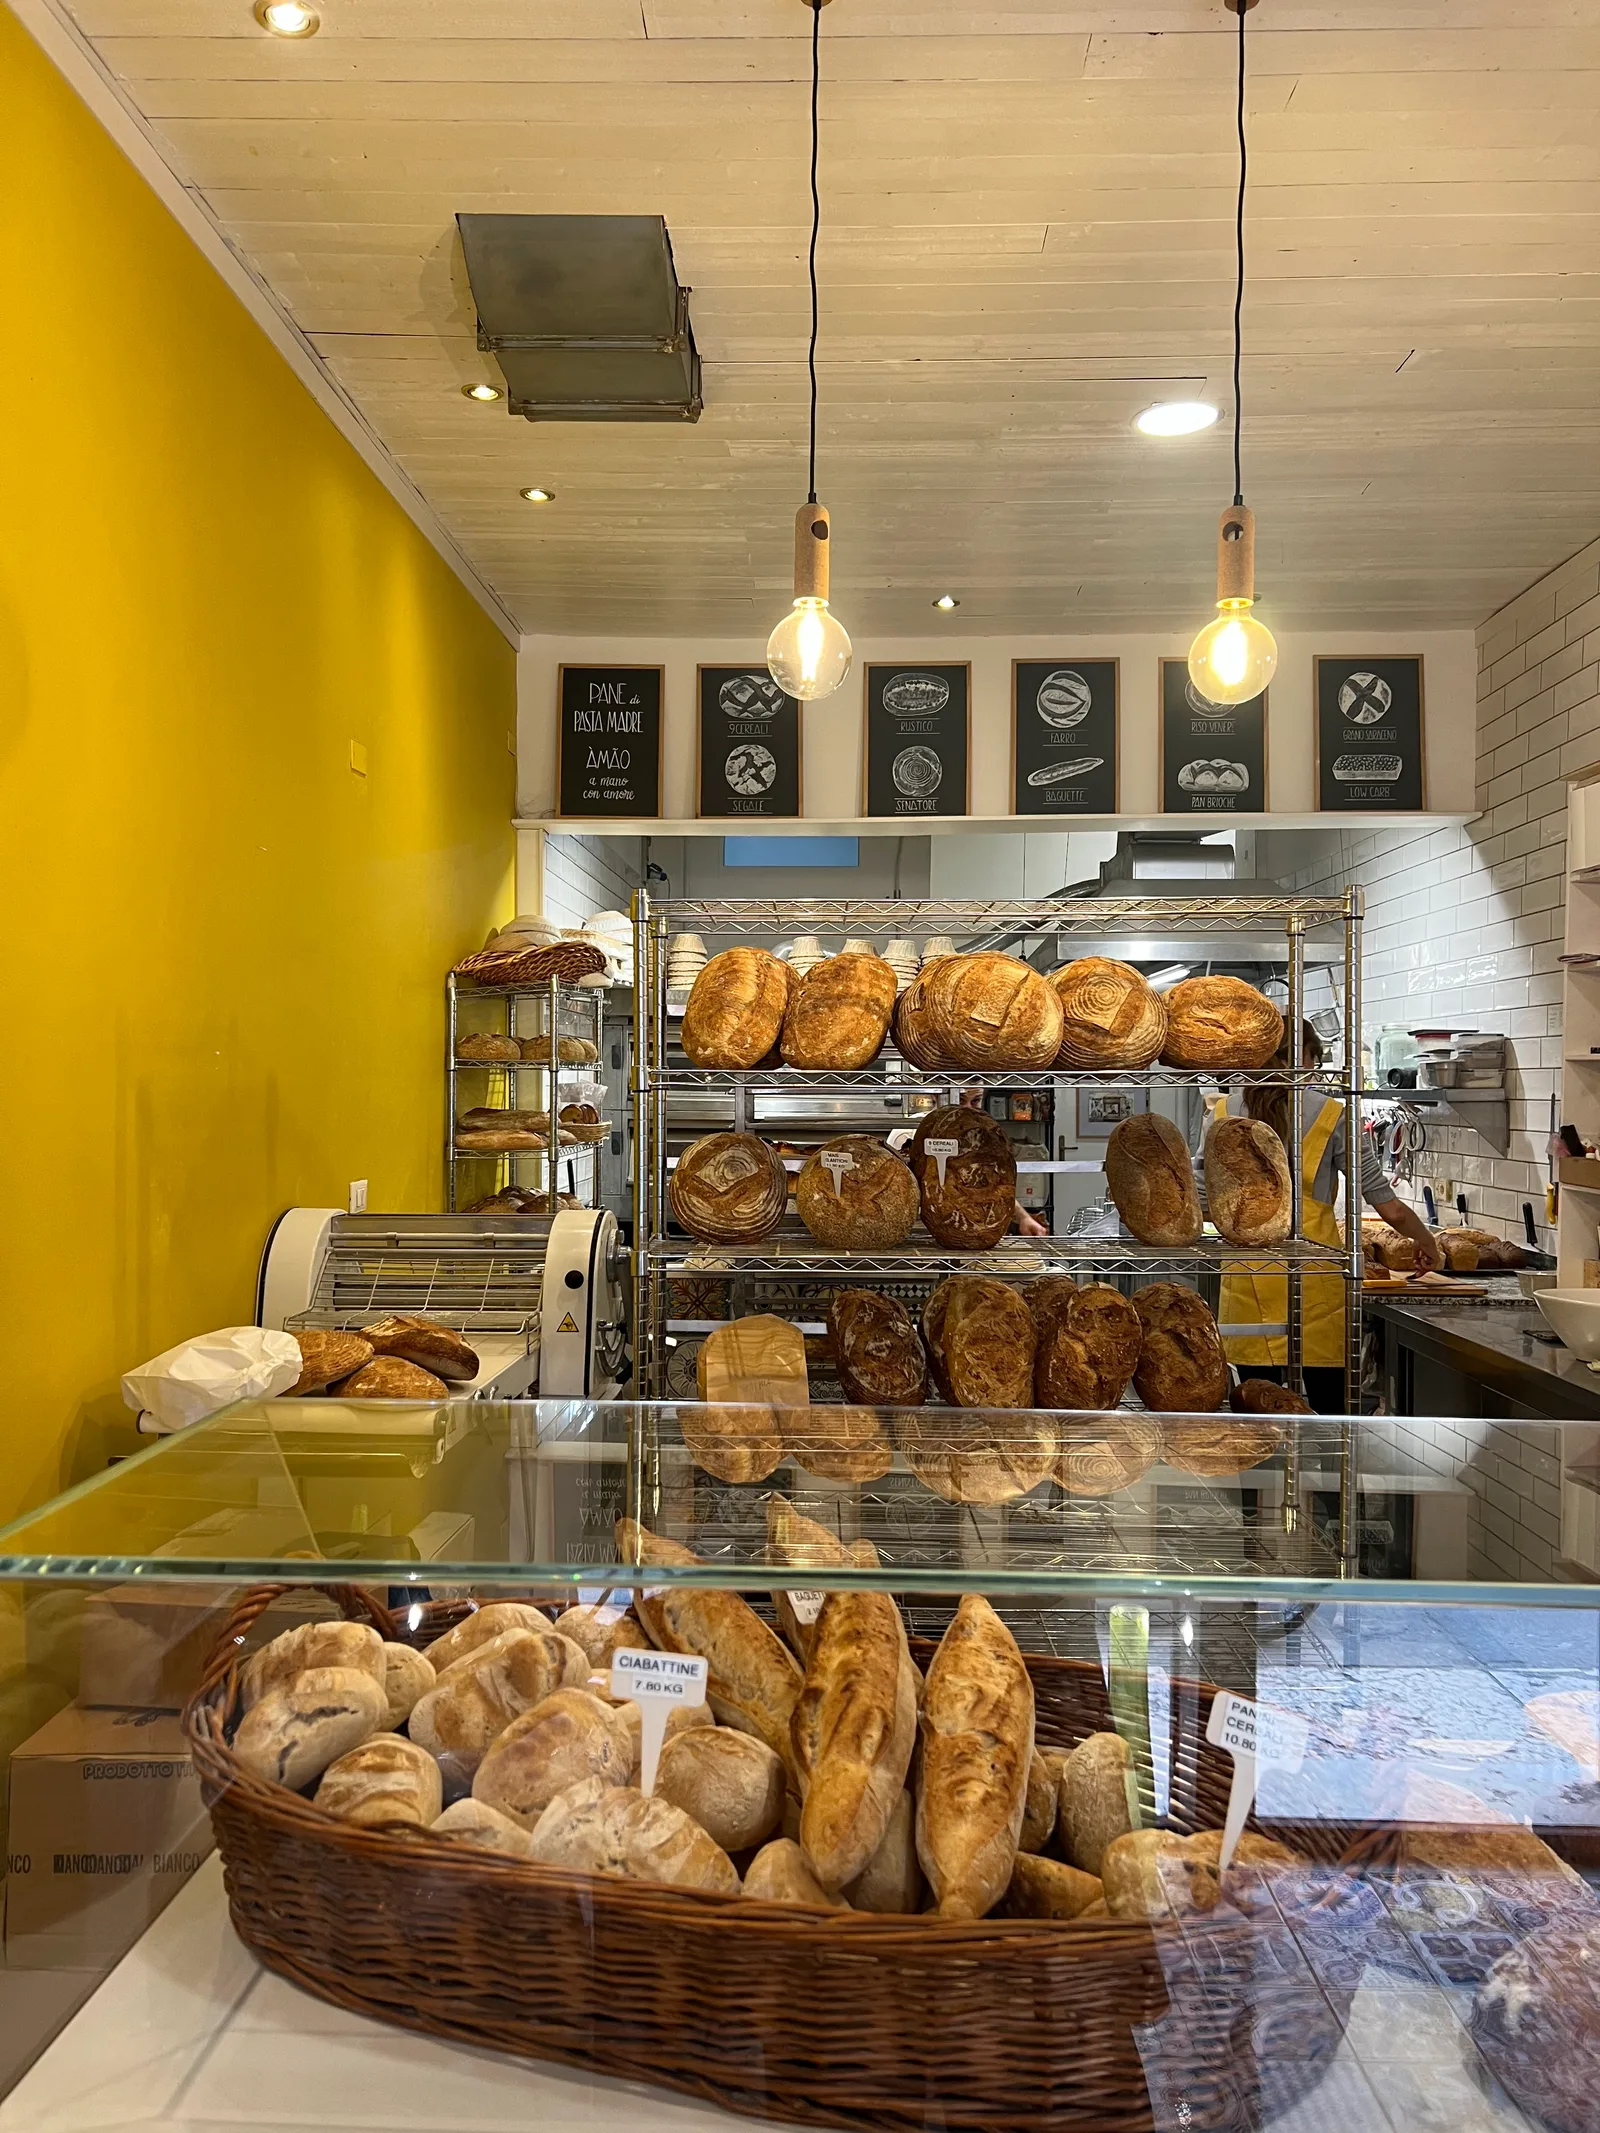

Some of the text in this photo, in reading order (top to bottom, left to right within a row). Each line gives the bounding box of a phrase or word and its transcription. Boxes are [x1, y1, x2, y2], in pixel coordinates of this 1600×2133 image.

[589, 682, 641, 705] PANE di
[574, 710, 644, 733] PASTA MADRE
[900, 720, 933, 732] RUSTICO
[1191, 721, 1207, 733] RISO
[1050, 732, 1076, 744] FARRO
[1342, 729, 1397, 741] GRANO SARACENO
[589, 776, 629, 787] a mano
[583, 789, 635, 801] con amore
[1045, 790, 1085, 802] BAGUETTE
[1350, 786, 1390, 798] LOW CARB
[732, 800, 765, 812] SEGALE
[895, 799, 937, 811] SENATORE
[1191, 796, 1236, 809] PAN BRIOCHE
[619, 1656, 700, 1677] CIABATTINE
[635, 1679, 683, 1694] 7.80 KG
[1224, 1732, 1257, 1752] 10.80
[83, 1762, 174, 1780] PRODOTTO
[153, 1854, 200, 1874] BIANCO
